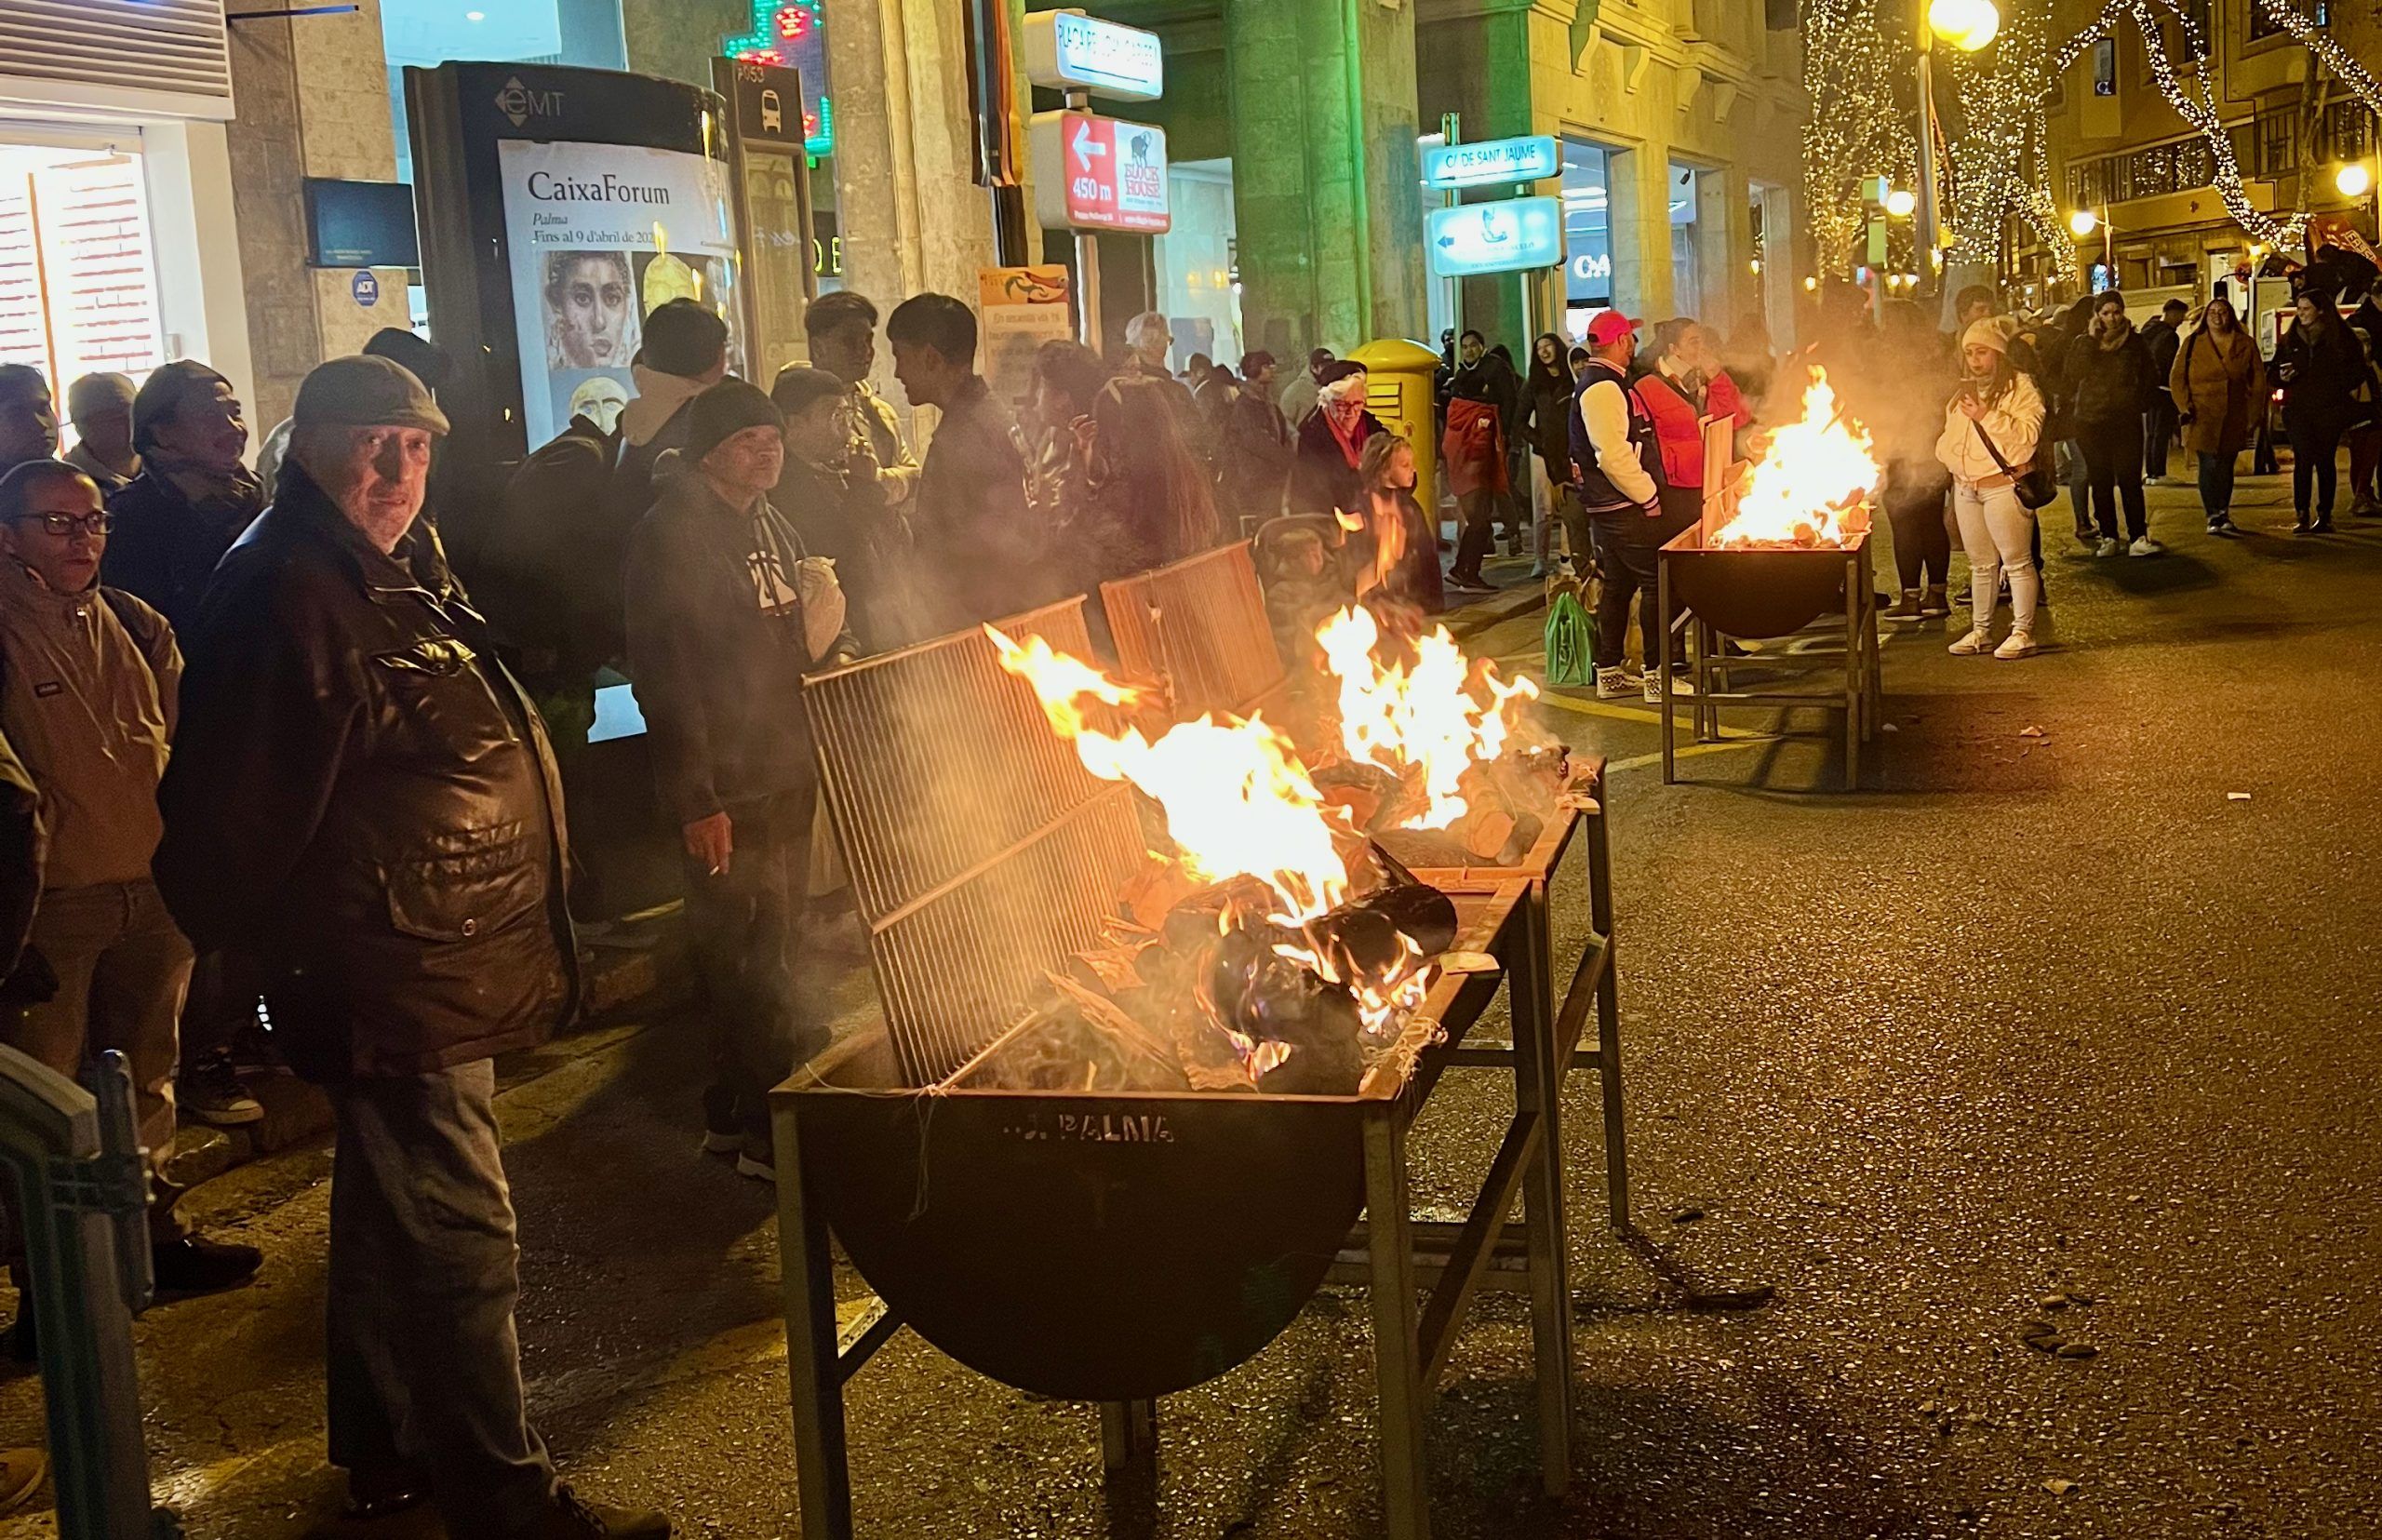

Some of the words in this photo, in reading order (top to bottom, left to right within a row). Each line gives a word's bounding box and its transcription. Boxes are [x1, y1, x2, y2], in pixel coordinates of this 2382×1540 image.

[1462, 152, 1475, 167] DE
[1478, 148, 1500, 165] SANT
[1505, 144, 1535, 162] JAUME
[1124, 163, 1159, 181] BLOCK
[528, 170, 670, 205] CaixaForum
[1073, 177, 1098, 200] 450
[1100, 184, 1112, 201] m
[1125, 180, 1161, 198] HOUSE
[532, 212, 569, 226] Palma
[533, 230, 559, 243] Fins
[563, 230, 573, 243] al
[576, 231, 584, 243] 9
[586, 231, 620, 244] d'abril
[622, 232, 635, 244] de
[356, 280, 374, 293] ADT
